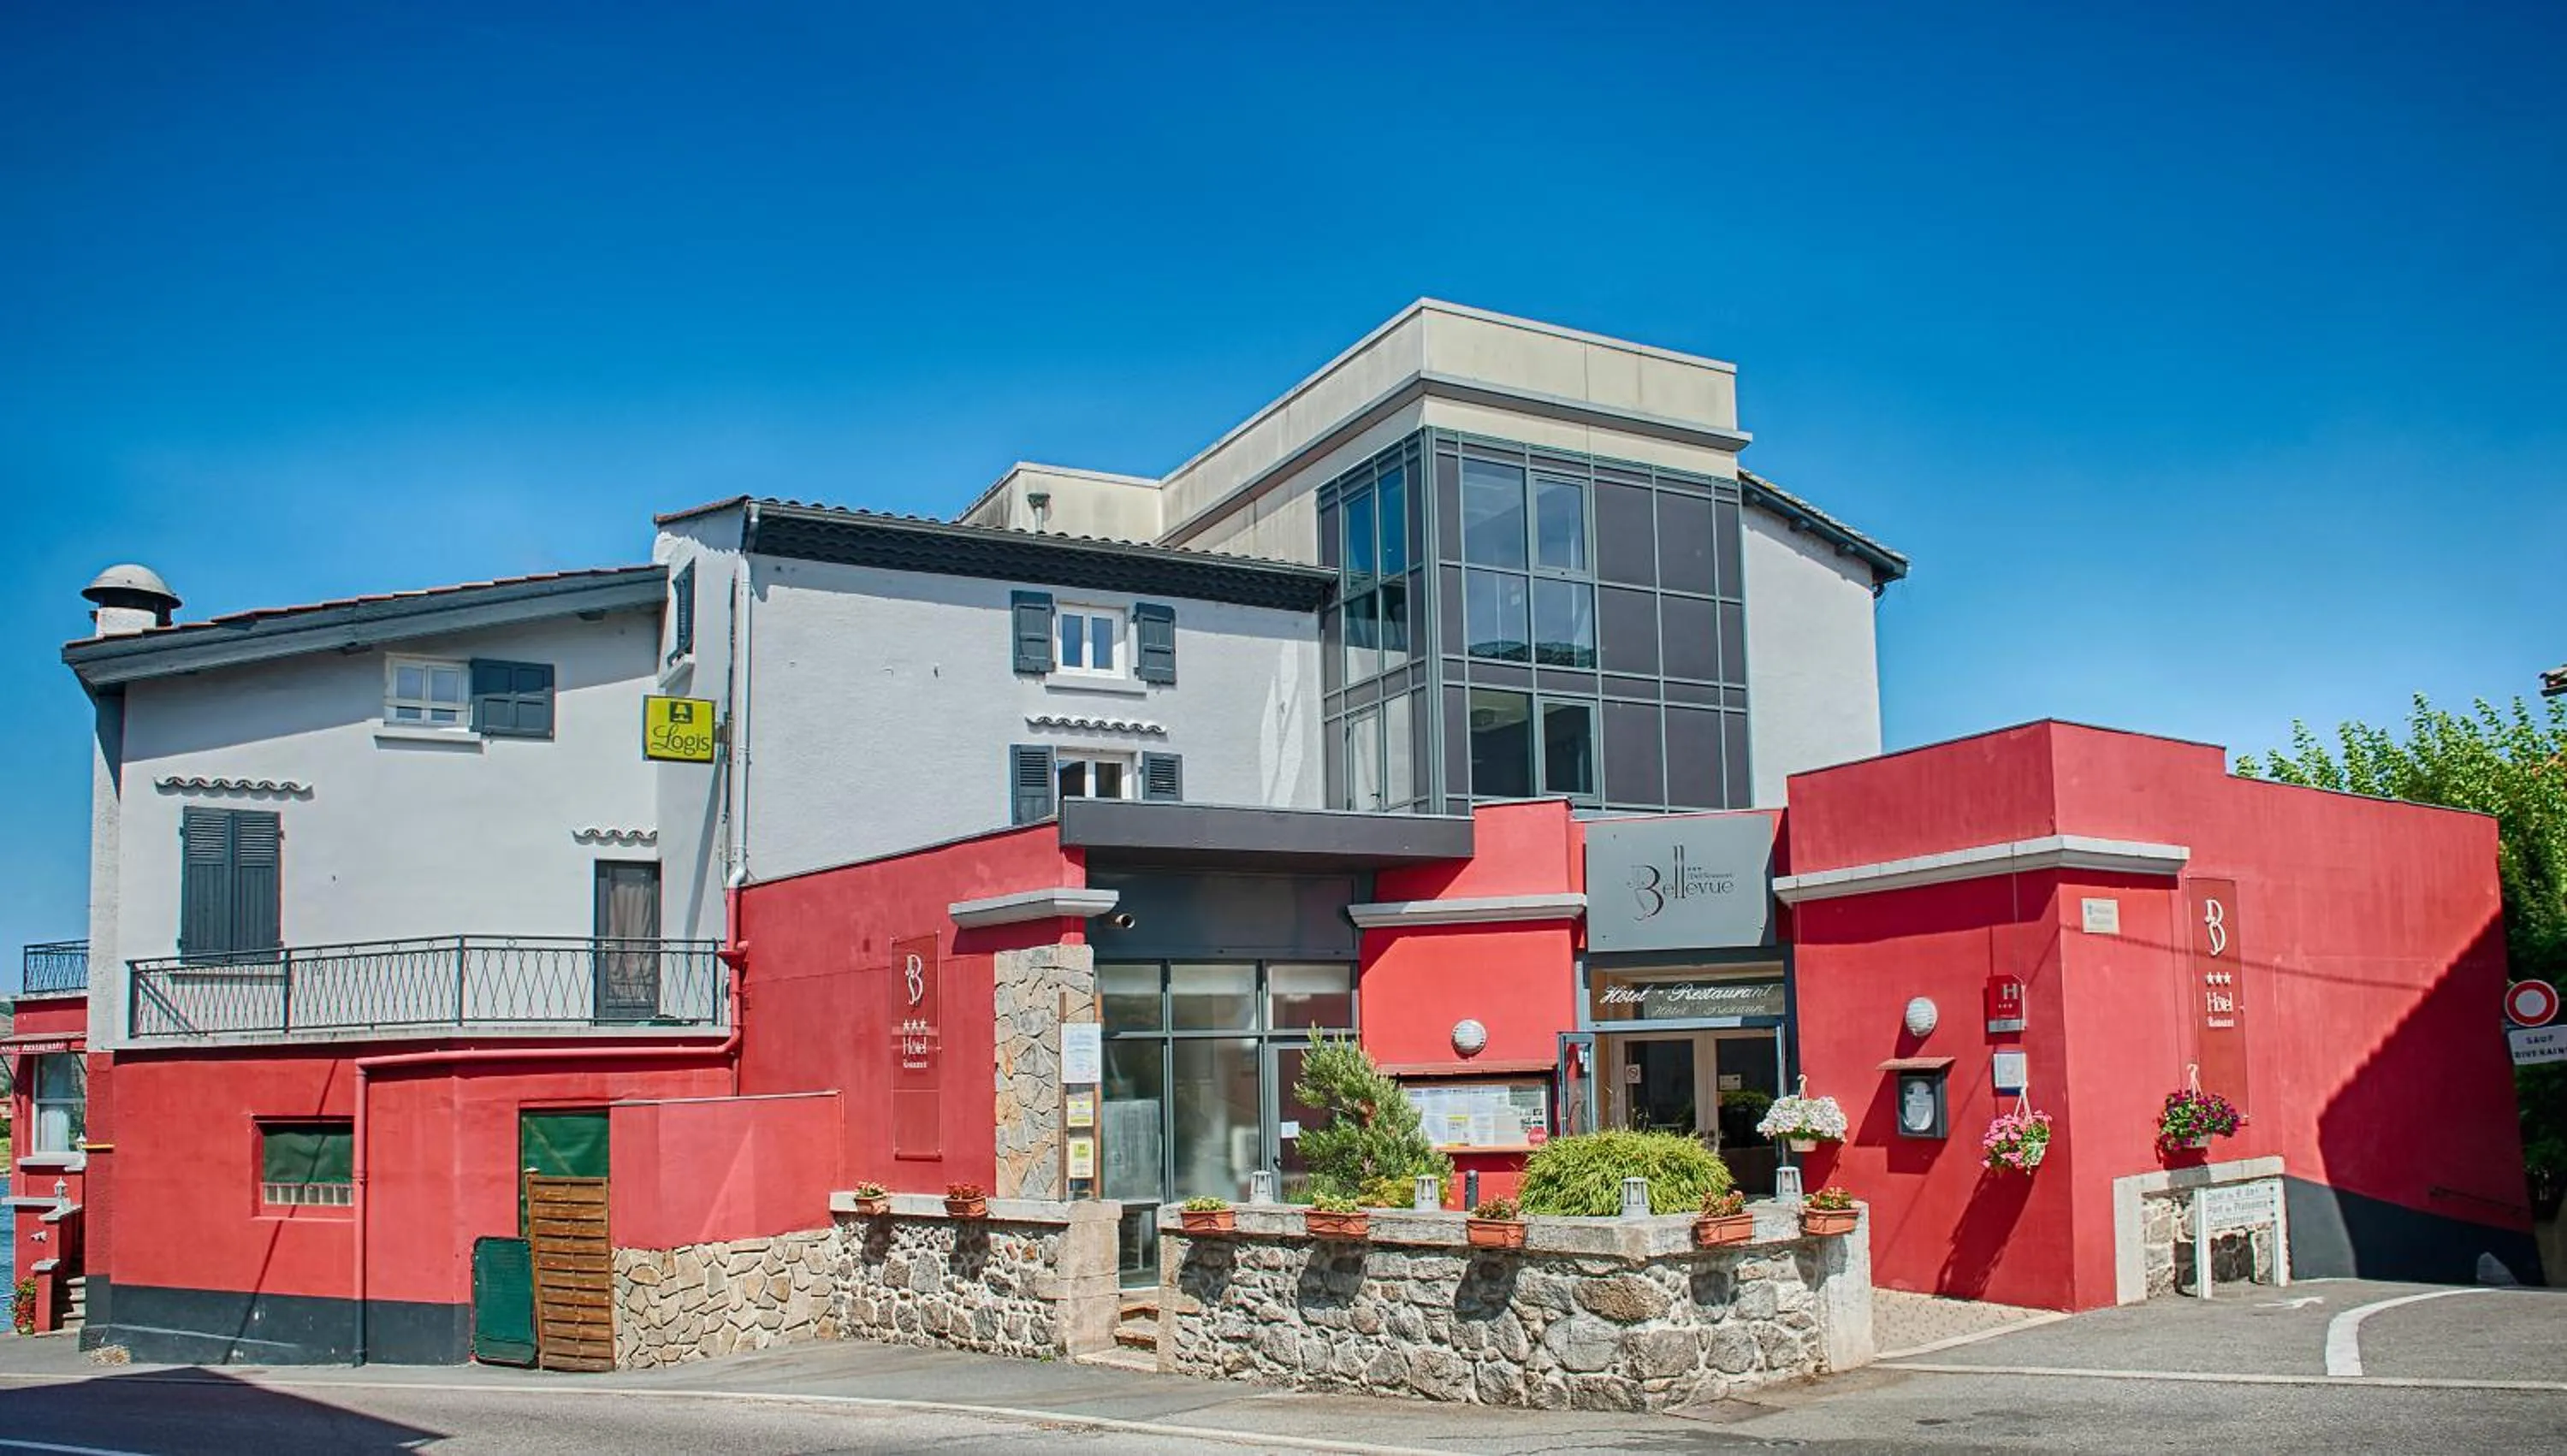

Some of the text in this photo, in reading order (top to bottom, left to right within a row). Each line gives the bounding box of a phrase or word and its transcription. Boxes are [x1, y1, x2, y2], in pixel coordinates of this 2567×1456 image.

[650, 723, 710, 756] Logis
[1627, 844, 1734, 921] Bellevue
[1668, 983, 1773, 1002] Restaurant
[2002, 983, 2019, 1000] H
